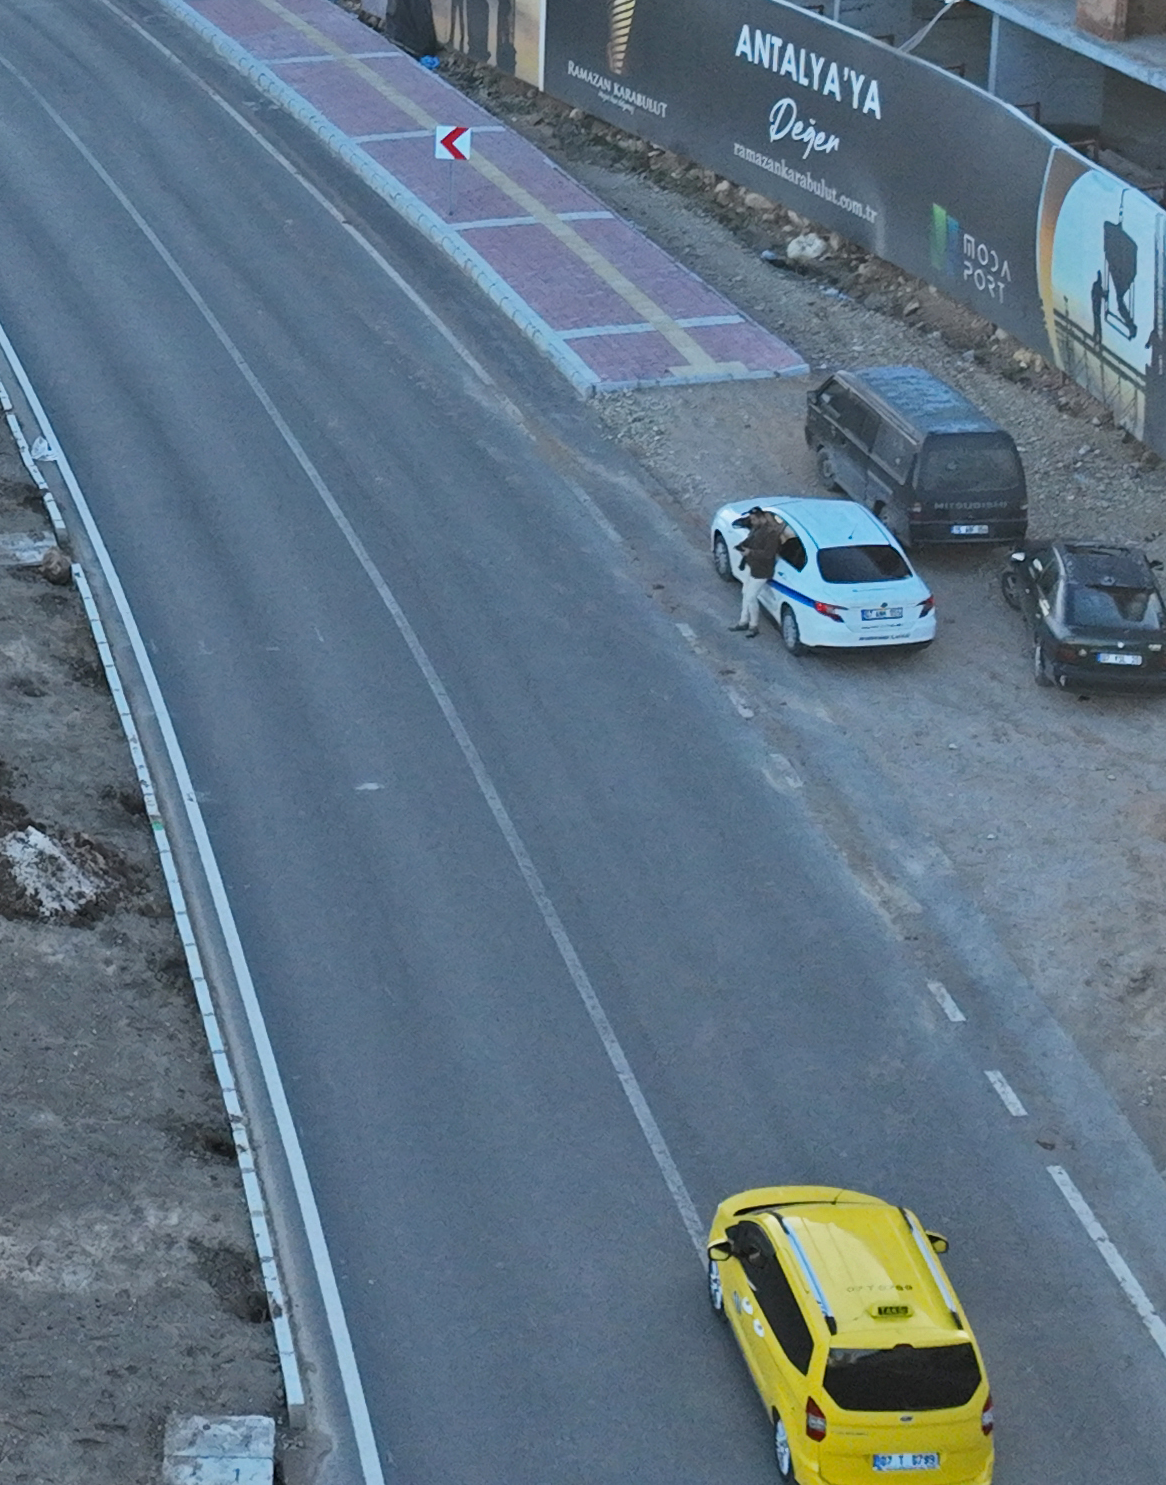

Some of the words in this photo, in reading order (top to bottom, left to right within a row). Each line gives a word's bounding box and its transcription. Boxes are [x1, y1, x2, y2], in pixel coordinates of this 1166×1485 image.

[567, 59, 612, 92] RAMAZAN
[613, 81, 668, 118] KARABULUT
[735, 24, 881, 120] ANTALYA'YA
[734, 142, 878, 224] ramazankarabulut.com.tr
[963, 260, 1005, 304] PORT
